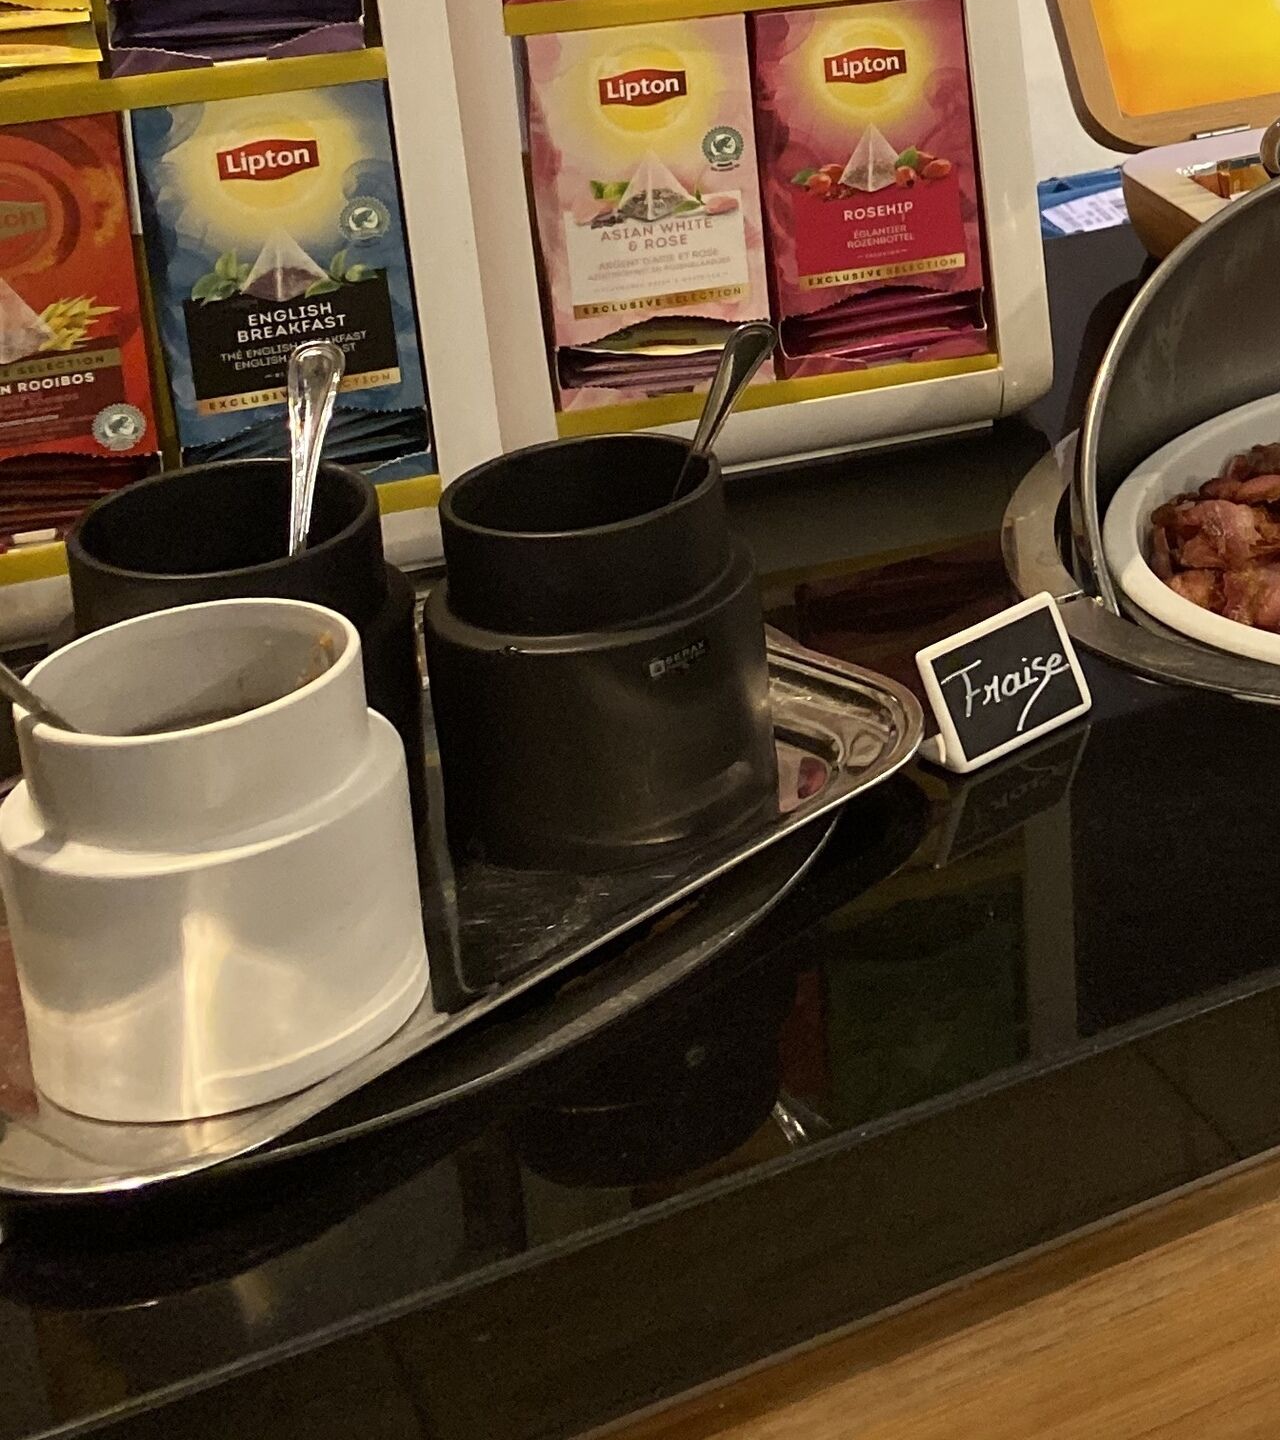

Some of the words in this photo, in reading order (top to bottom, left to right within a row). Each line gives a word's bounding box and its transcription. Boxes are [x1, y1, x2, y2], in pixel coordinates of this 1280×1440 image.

[831, 54, 900, 79] Lipton
[606, 77, 679, 101] Lipton
[225, 146, 311, 175] Lipton
[843, 201, 914, 221] ROSEHIP
[601, 226, 654, 242] ASIAN
[659, 218, 713, 234] WHITE
[644, 234, 689, 250] ROSE
[847, 232, 914, 249] ROZENBOTTEL
[808, 269, 882, 286] EXCLUSIVE
[886, 257, 958, 276] SELECTION
[582, 299, 661, 315] EXCLUSIVE
[666, 287, 742, 305] SELECTION
[248, 302, 333, 327] ENGLISH
[237, 314, 347, 344] BREAKFAST
[235, 354, 287, 371] ENGLISH
[246, 343, 298, 358] ENGLISH
[17, 356, 104, 374] SELECTION
[17, 372, 95, 393] ROOIBOS
[209, 391, 289, 410] EXCLUSIV
[941, 652, 1070, 731] Fraise
